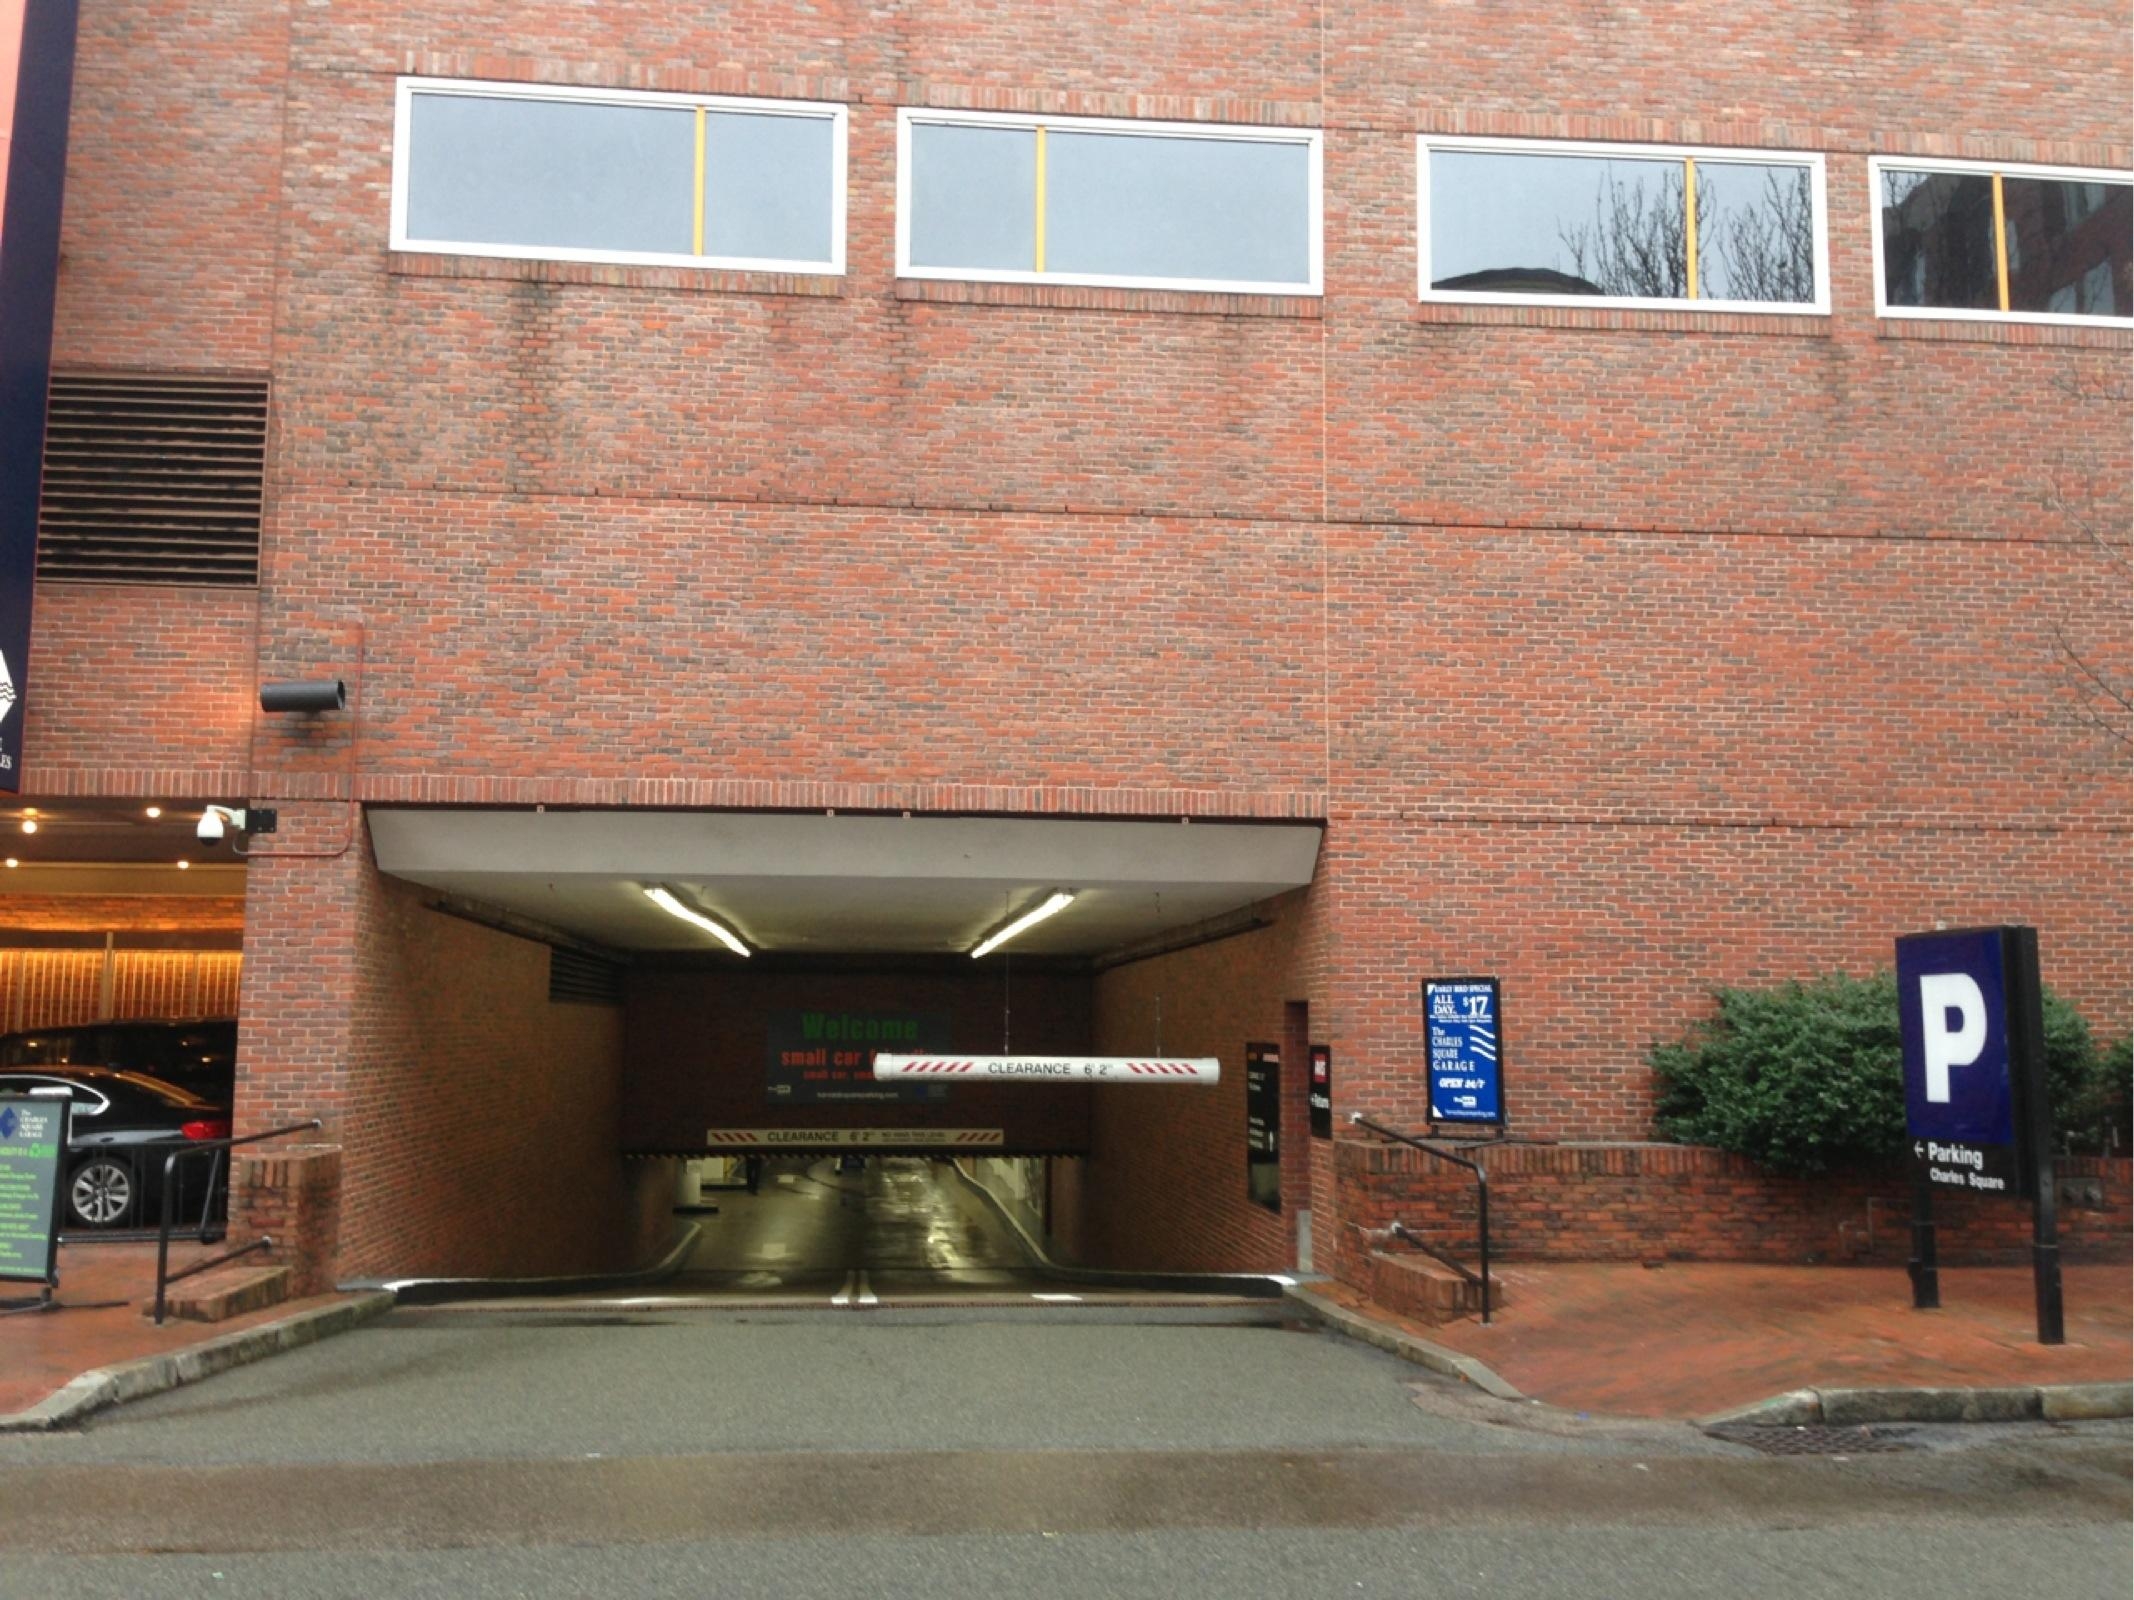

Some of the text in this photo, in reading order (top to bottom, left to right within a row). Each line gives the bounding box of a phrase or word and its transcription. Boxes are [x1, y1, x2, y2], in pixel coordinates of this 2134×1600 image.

[1435, 995, 1453, 1003] ALL
[802, 1013, 918, 1041] Welcome
[1432, 1027, 1445, 1036] The
[1432, 1037, 1462, 1047] CHARLES
[1919, 972, 1988, 1103] P
[781, 1048, 827, 1066] small
[833, 1050, 863, 1067] car
[1433, 1048, 1458, 1060] SQUARE
[987, 1062, 1071, 1075] CLEARANCE
[1433, 1061, 1475, 1072] GARAGE
[1439, 1077, 1463, 1088] OPEN
[766, 1131, 839, 1143] CLEARANCE
[1927, 1141, 1984, 1171] Parking
[1930, 1167, 2005, 1190] Charles Square
